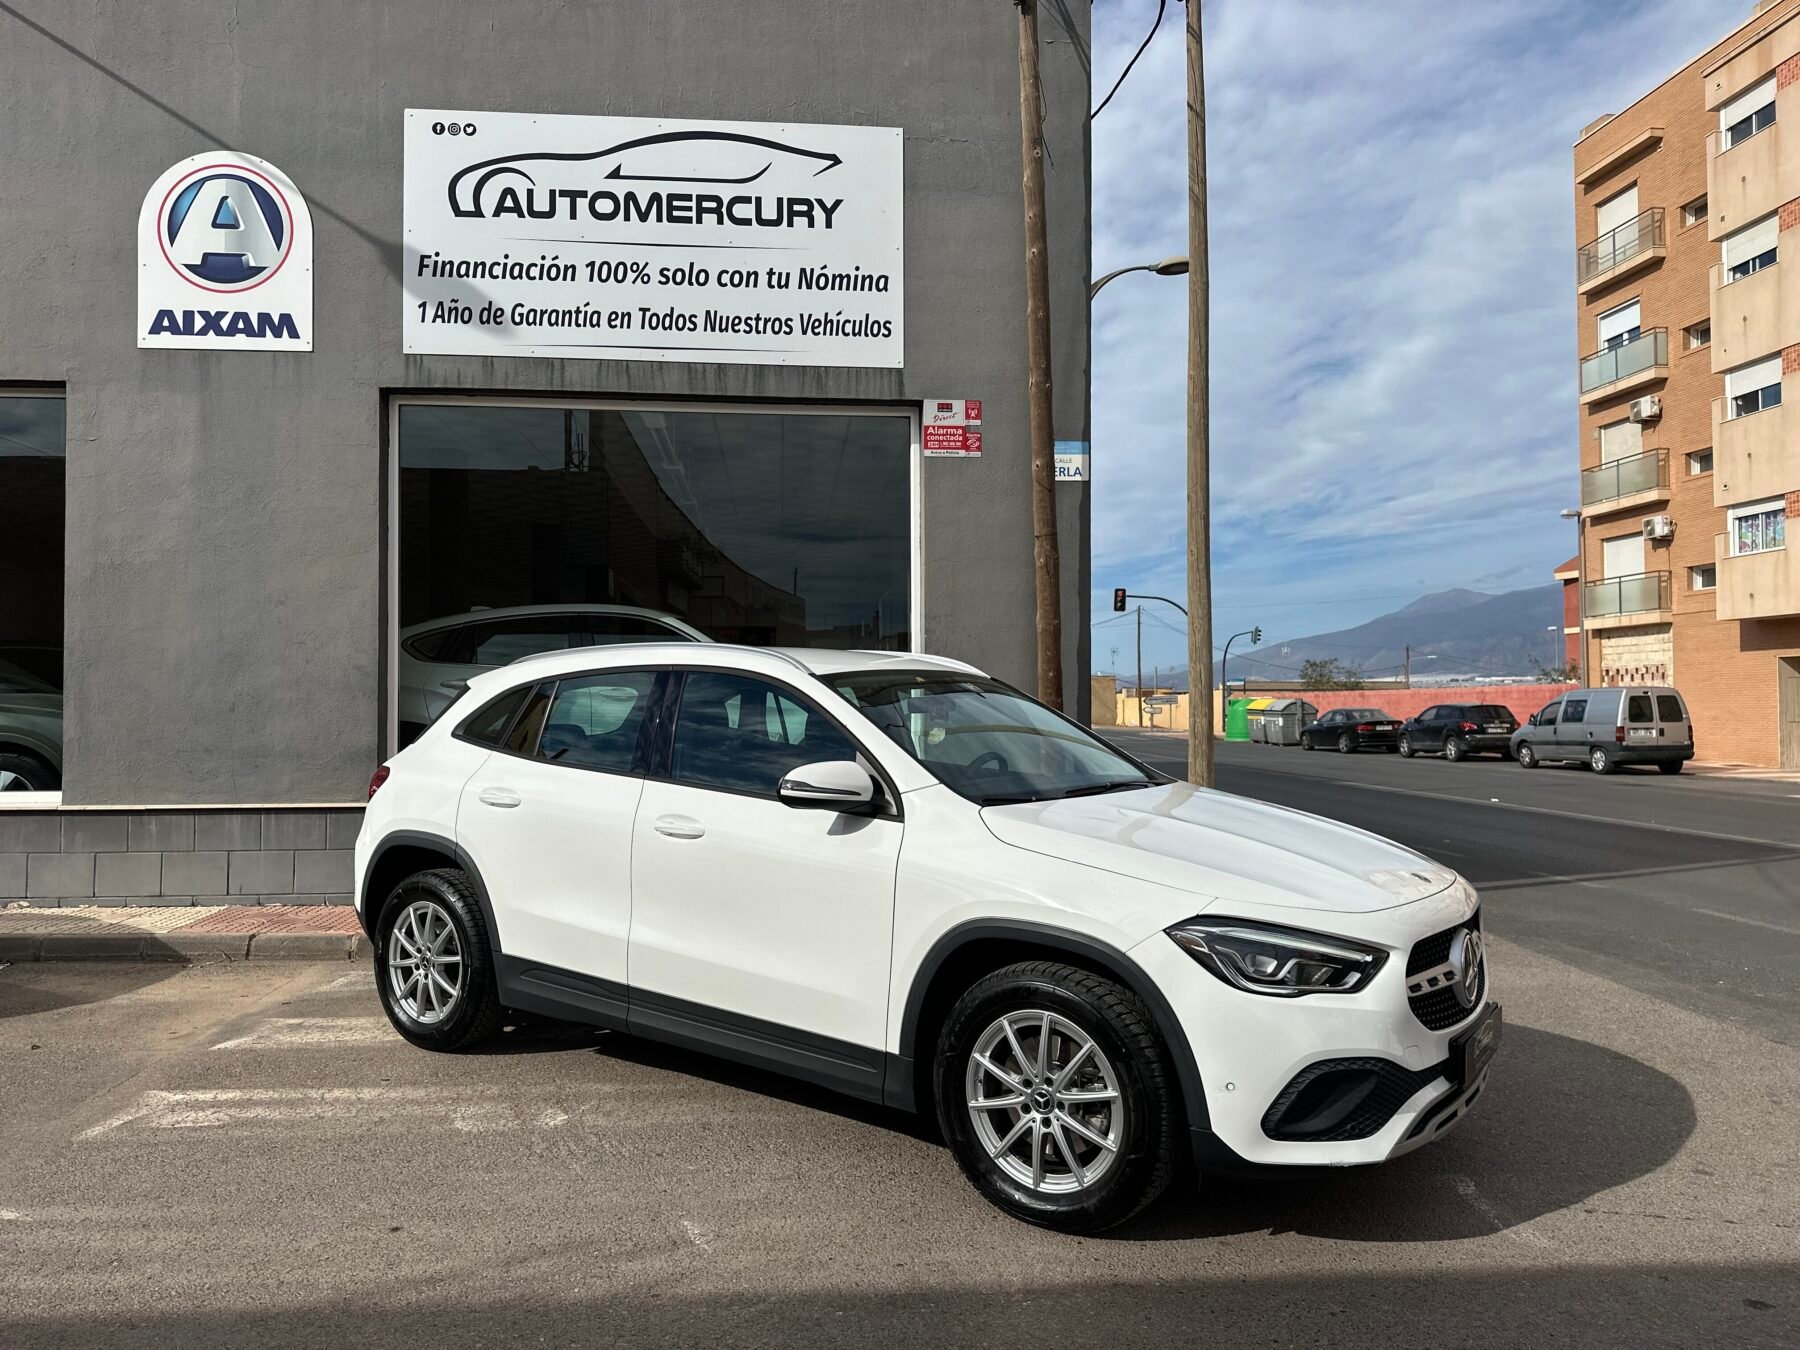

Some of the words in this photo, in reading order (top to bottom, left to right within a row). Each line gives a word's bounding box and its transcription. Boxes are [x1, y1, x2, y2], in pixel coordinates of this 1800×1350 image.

[492, 186, 844, 229] AUTOMERCURY
[417, 251, 577, 282] Financiación
[585, 260, 651, 285] 100%
[658, 261, 710, 287] solo
[716, 268, 759, 289] con
[766, 267, 791, 290] tu
[798, 264, 889, 293] Nómina
[148, 309, 300, 339] AIXAM
[417, 300, 428, 323] 1
[432, 298, 473, 325] Año
[479, 300, 505, 326] de
[510, 301, 602, 329] Garantía
[607, 310, 632, 330] en
[638, 306, 698, 332] Todos
[703, 309, 794, 336] Nuestros
[799, 310, 892, 338] Vehículos
[927, 426, 963, 435] Alarma
